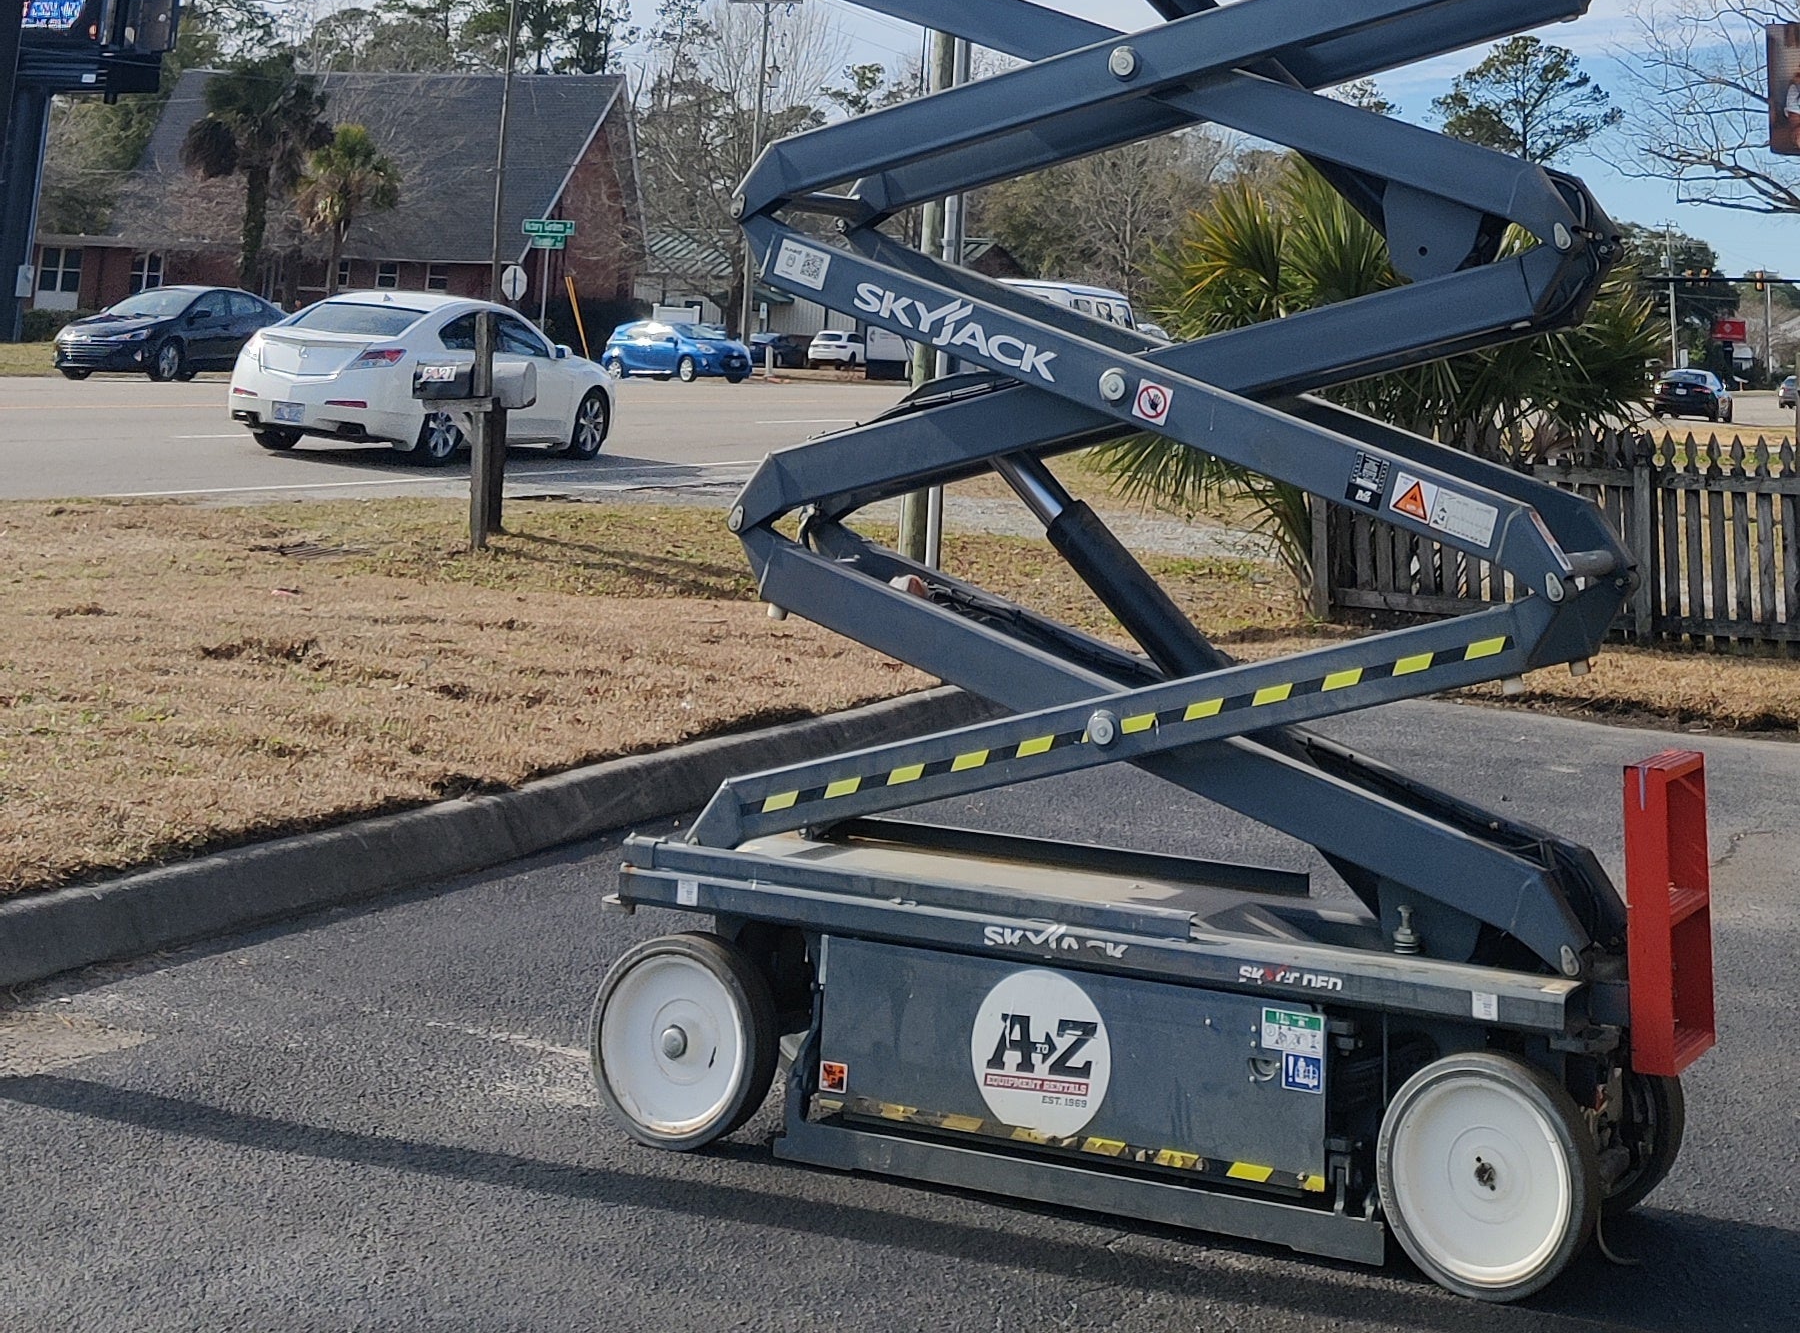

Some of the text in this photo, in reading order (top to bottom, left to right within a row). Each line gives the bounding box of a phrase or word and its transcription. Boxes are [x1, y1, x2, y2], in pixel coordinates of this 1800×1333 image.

[854, 283, 1058, 382] SKYJACK
[986, 1075, 1087, 1095] EQUIPMENT RENTALS
[1042, 1095, 1088, 1108] EST. 1969
